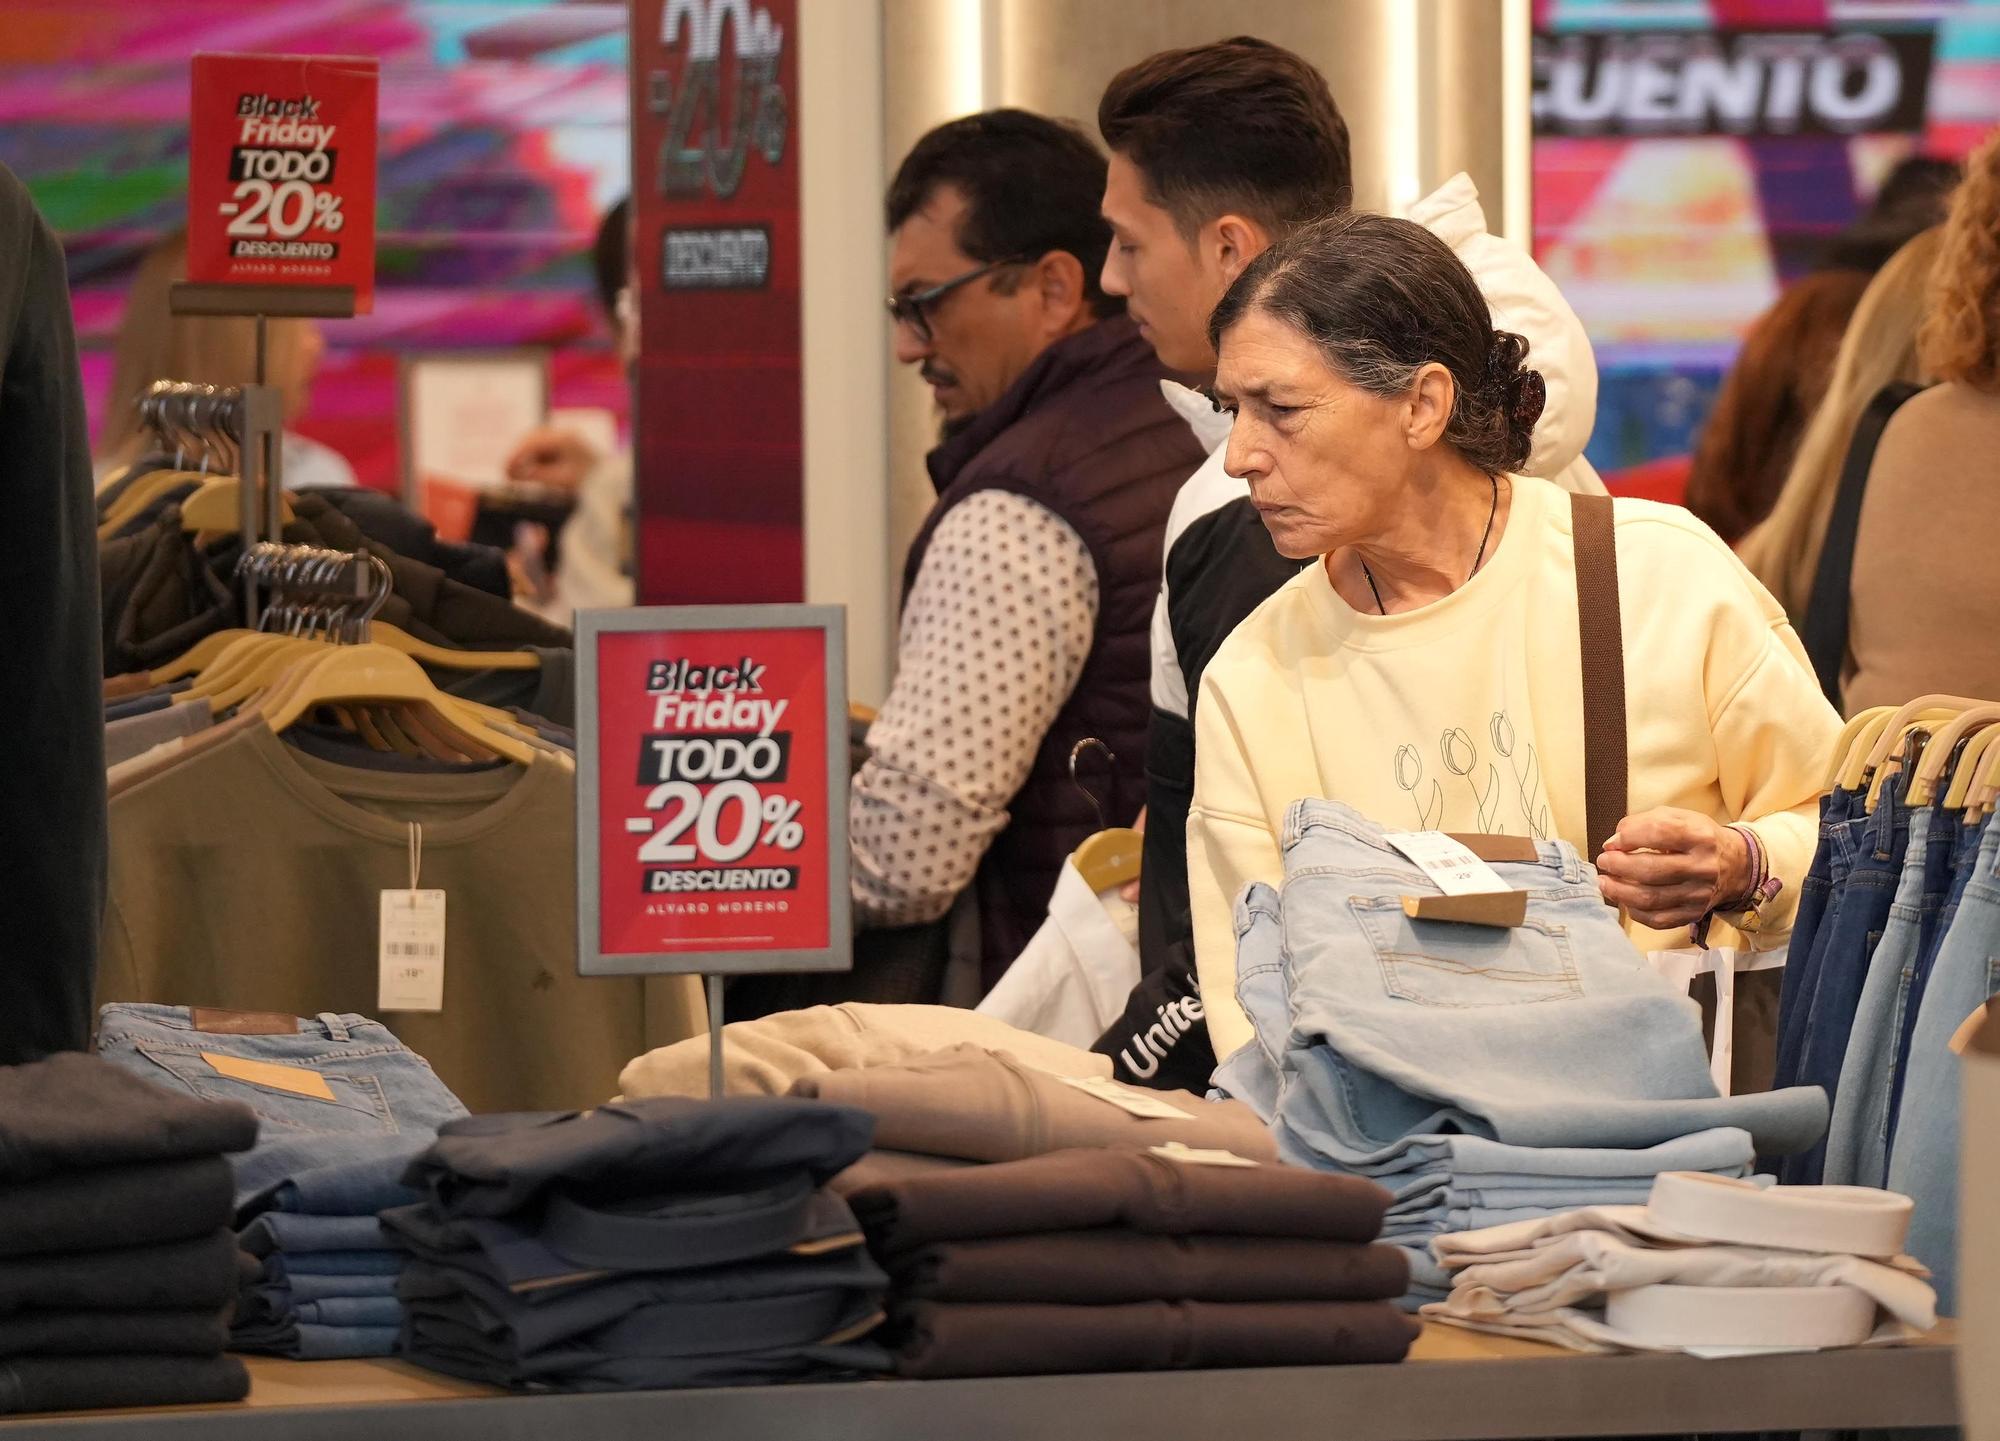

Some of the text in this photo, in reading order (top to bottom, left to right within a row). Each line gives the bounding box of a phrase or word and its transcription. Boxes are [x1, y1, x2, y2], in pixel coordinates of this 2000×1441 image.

[238, 94, 320, 119] Black
[241, 118, 335, 151] Friday
[241, 150, 329, 179] TODO
[219, 179, 343, 238] -20%
[235, 242, 333, 257] DESCUENTO
[646, 658, 766, 695] Black
[653, 692, 787, 739] Friday
[652, 738, 780, 780] TODO
[626, 780, 804, 863] -20%
[651, 869, 790, 891] DESCUENTO
[646, 900, 789, 914] ALVARO MORENO
[1121, 972, 1205, 1079] Unite
